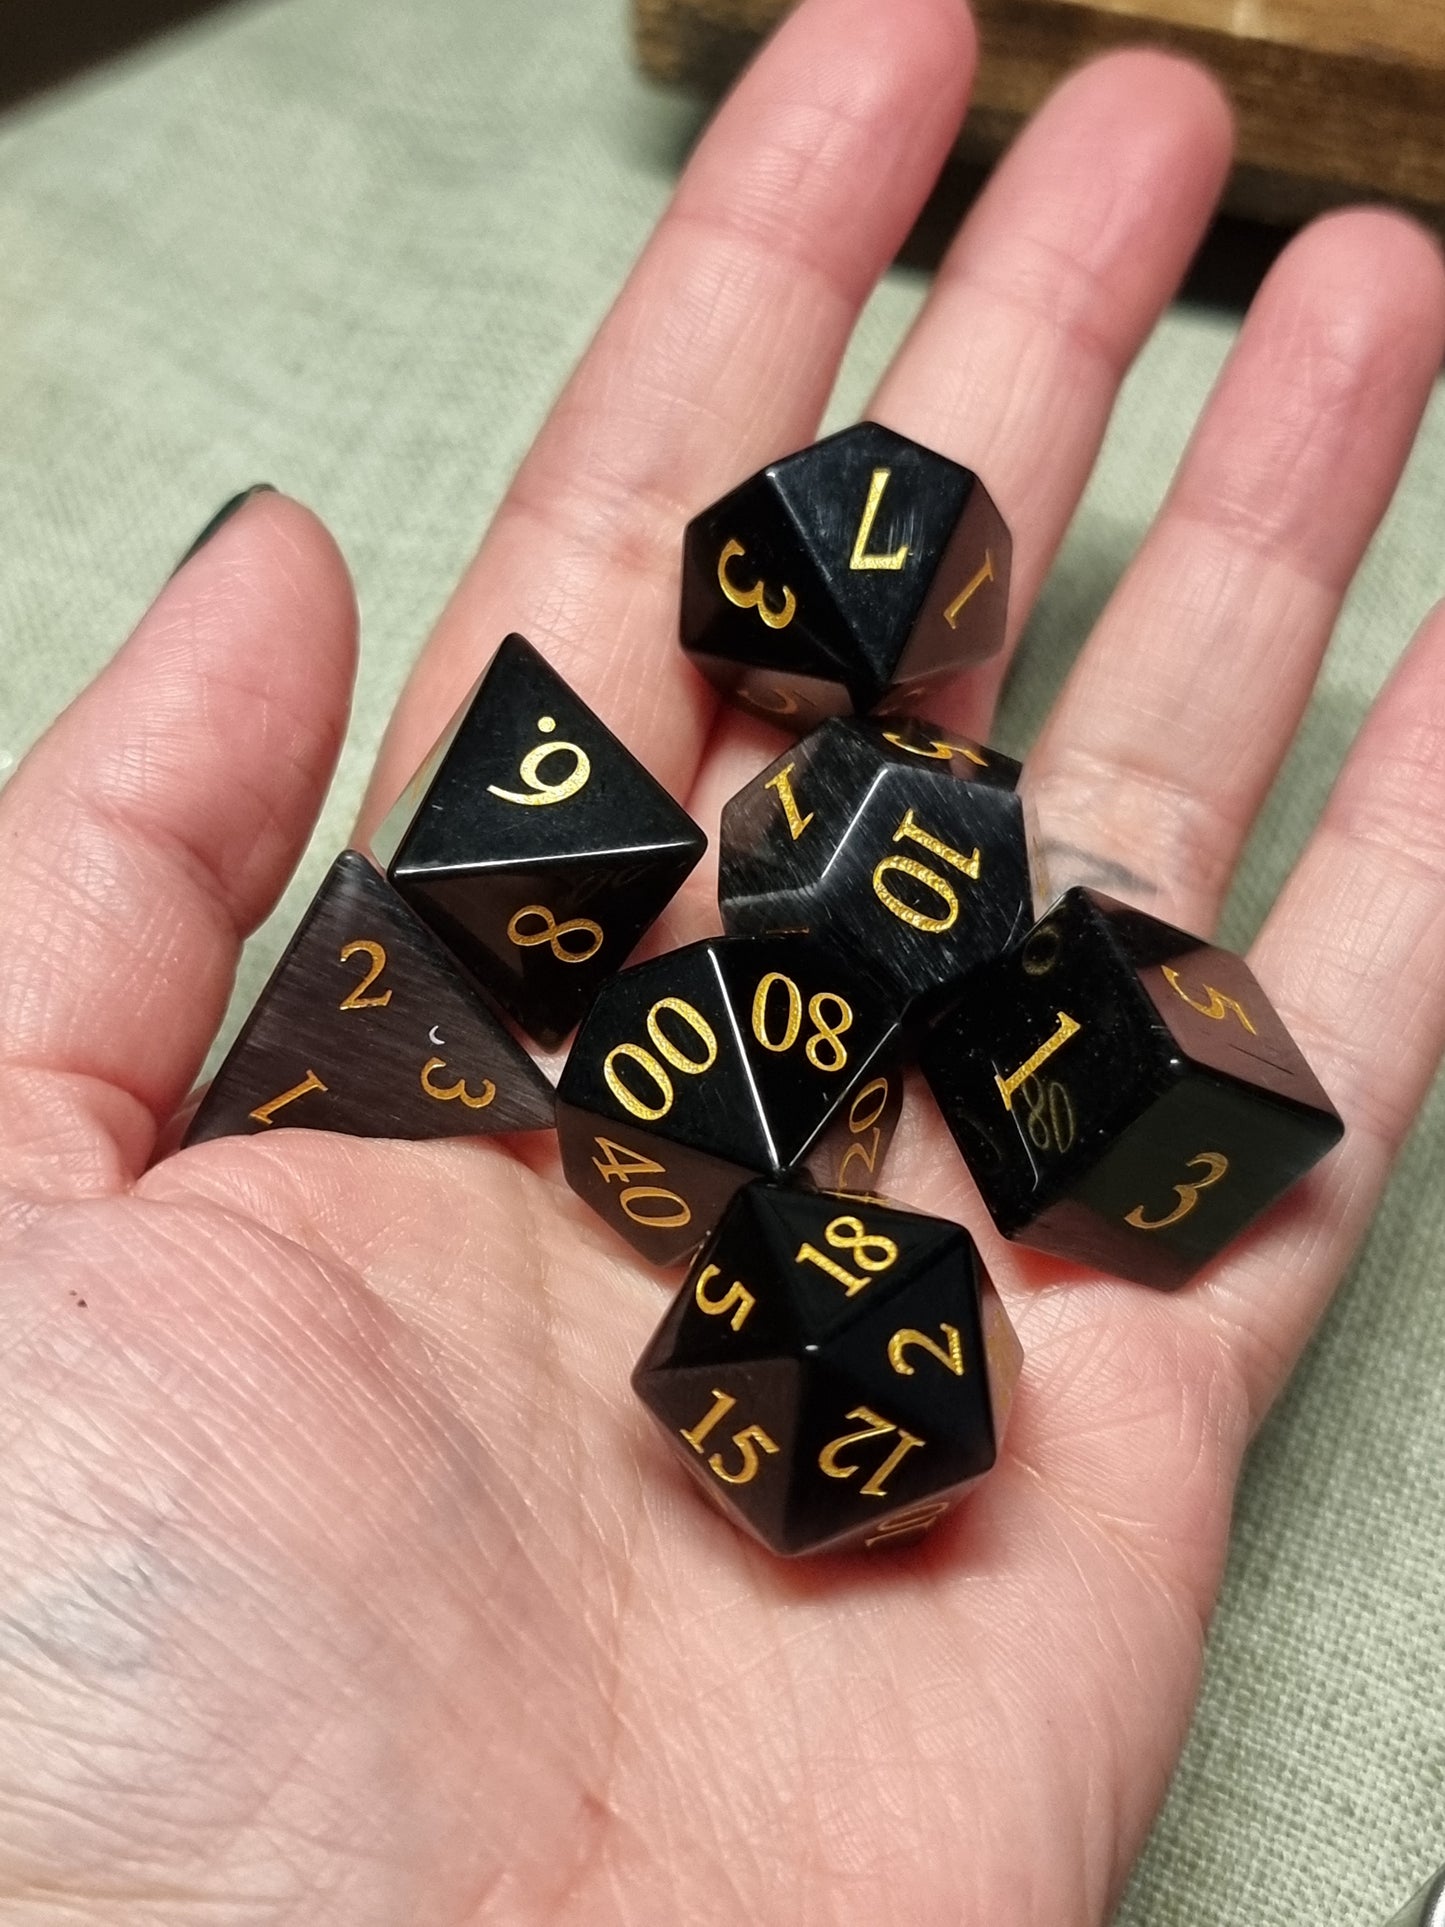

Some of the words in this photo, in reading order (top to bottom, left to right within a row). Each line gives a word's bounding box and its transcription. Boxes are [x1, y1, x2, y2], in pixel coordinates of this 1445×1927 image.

[850, 467, 909, 570] 7
[718, 539, 796, 629] 3
[943, 548, 994, 630] 1
[765, 762, 814, 840] 1
[873, 808, 981, 933] 10
[340, 939, 393, 1011] 2
[507, 905, 604, 964] 8
[1161, 965, 1257, 1036] 5
[249, 1069, 329, 1125] 1
[420, 1057, 496, 1109] 3
[604, 997, 718, 1120] 00
[994, 1010, 1081, 1111] 1
[838, 1077, 888, 1190] 20
[591, 1136, 692, 1228] 40
[1124, 1152, 1229, 1229] 3
[795, 1215, 898, 1297] 18
[695, 1263, 755, 1332] 5
[888, 1322, 965, 1376] 2
[680, 1387, 780, 1484] 15
[818, 1405, 925, 1497] 12
